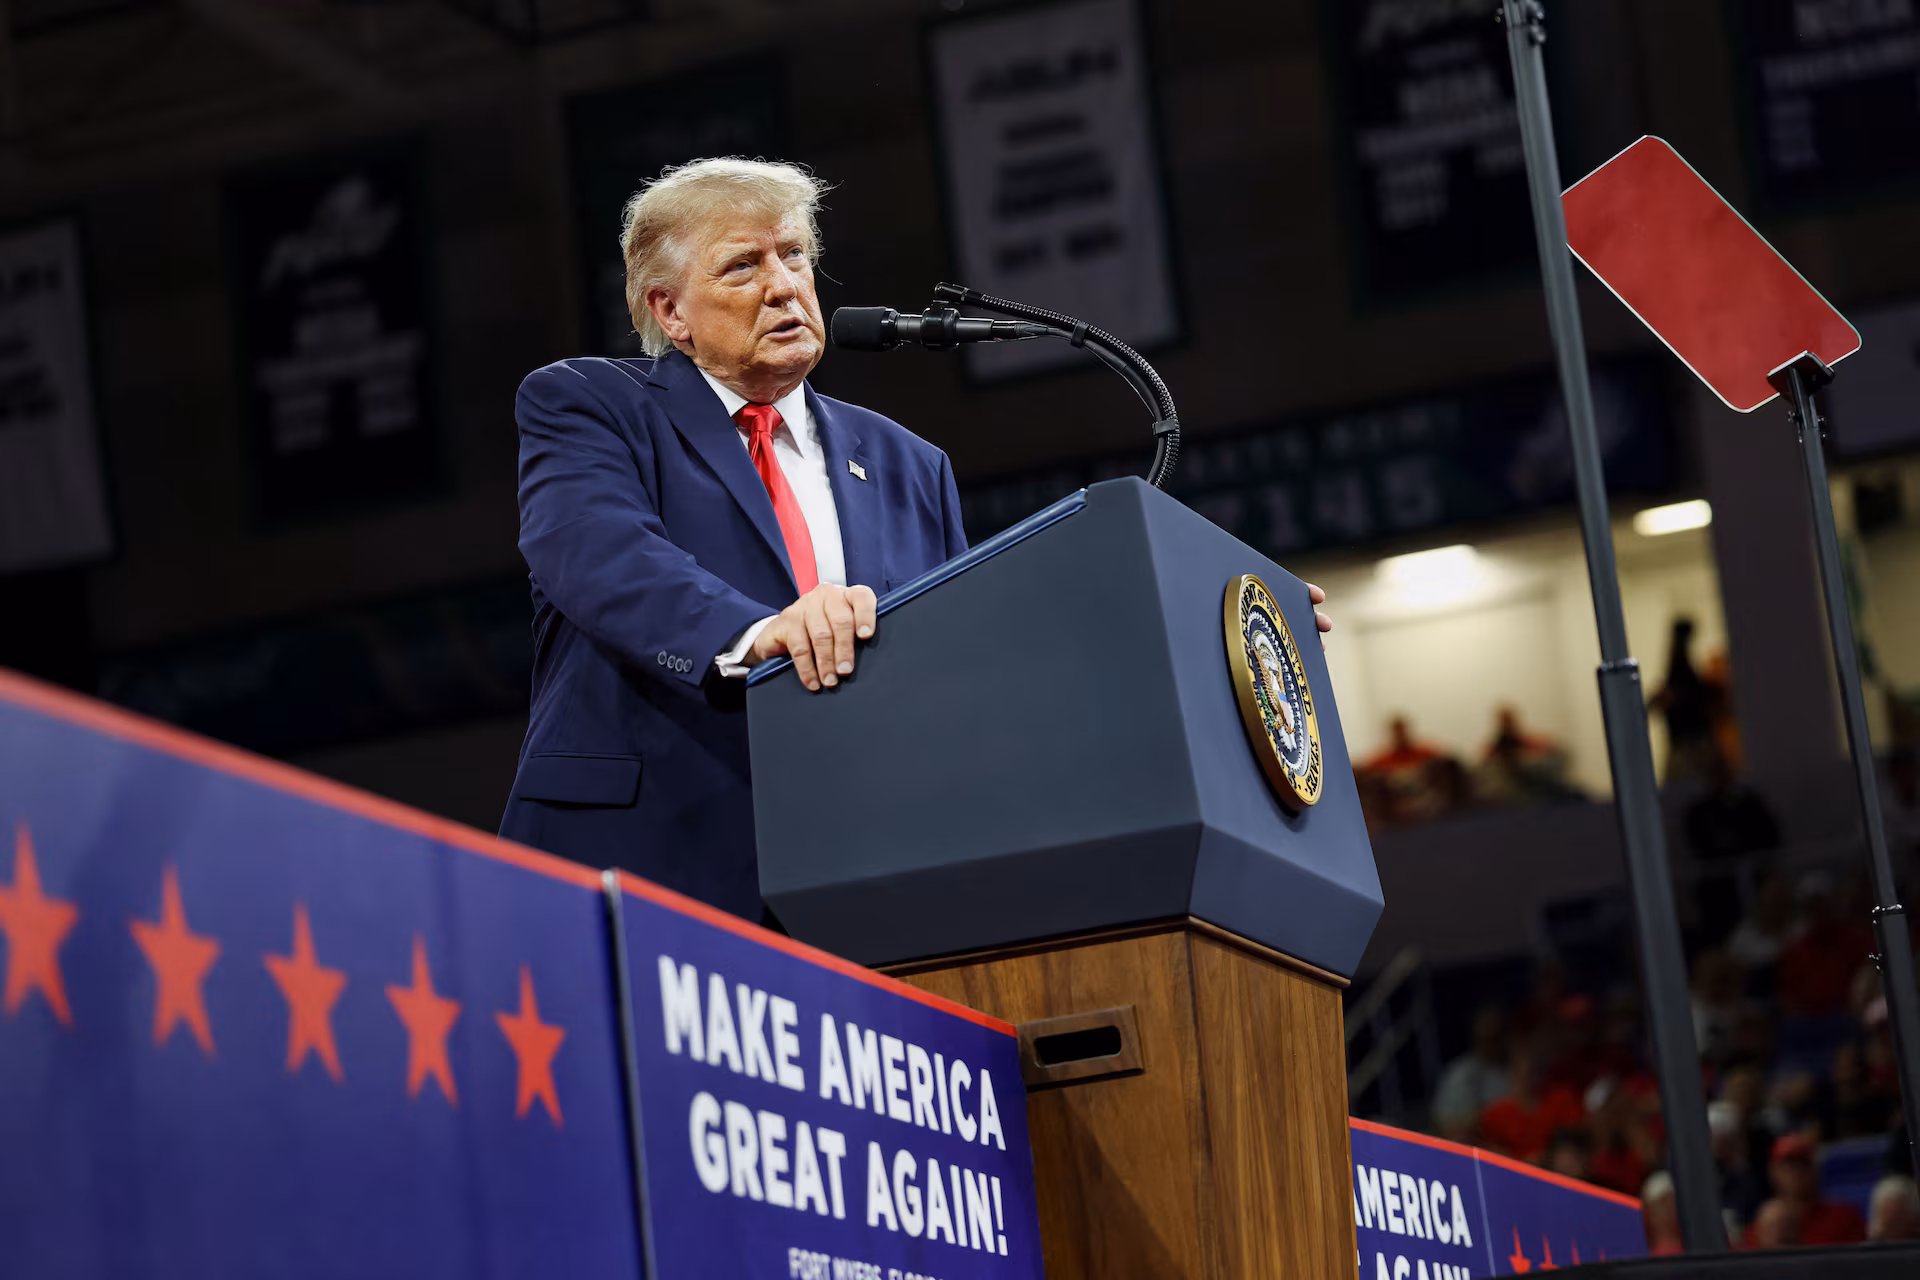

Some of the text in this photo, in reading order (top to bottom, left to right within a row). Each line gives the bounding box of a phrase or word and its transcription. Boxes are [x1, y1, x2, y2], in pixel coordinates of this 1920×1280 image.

[1280, 621, 1313, 716] UNITED
[658, 955, 1006, 1150] MAKE AMERICA
[689, 1091, 1009, 1256] GREAT AGAIN!
[788, 1247, 831, 1280] FORT
